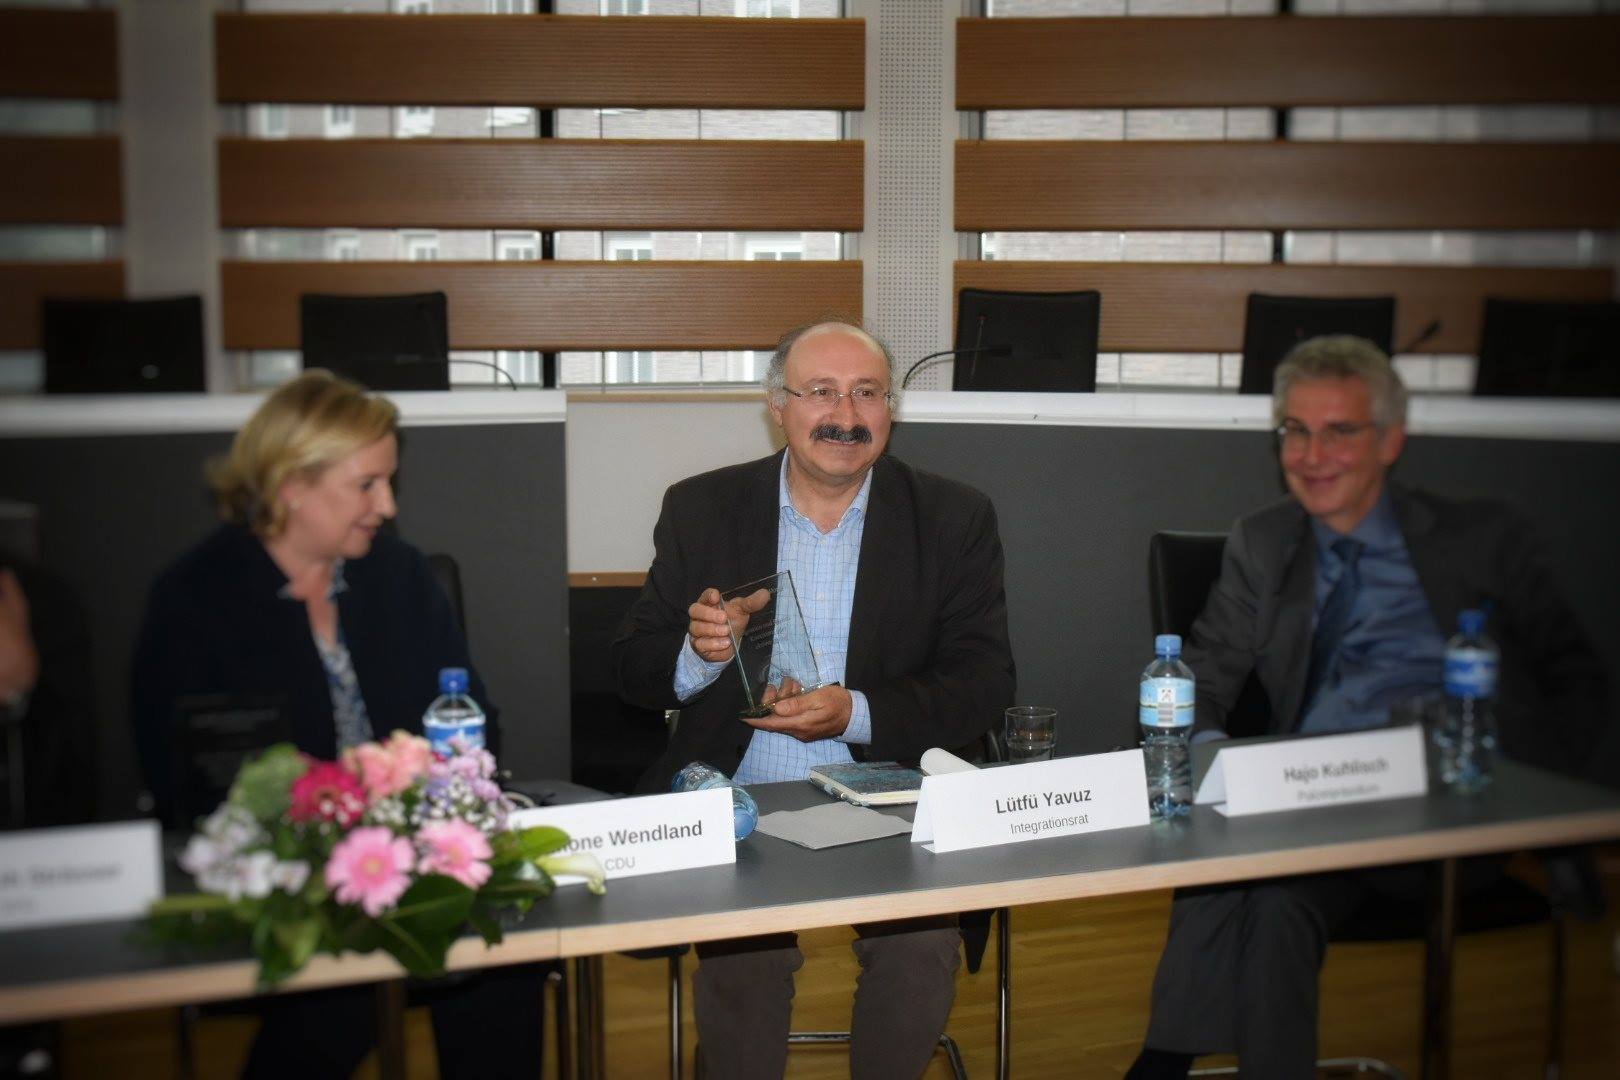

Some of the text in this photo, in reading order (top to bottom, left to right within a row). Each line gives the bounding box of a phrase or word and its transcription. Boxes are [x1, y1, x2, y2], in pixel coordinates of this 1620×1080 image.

[1284, 766, 1320, 785] Hajo
[995, 788, 1092, 815] Lütfü Yavuz
[1010, 814, 1090, 835] Integrationsrat
[557, 819, 703, 853] one Wendland
[604, 856, 636, 872] CDU
